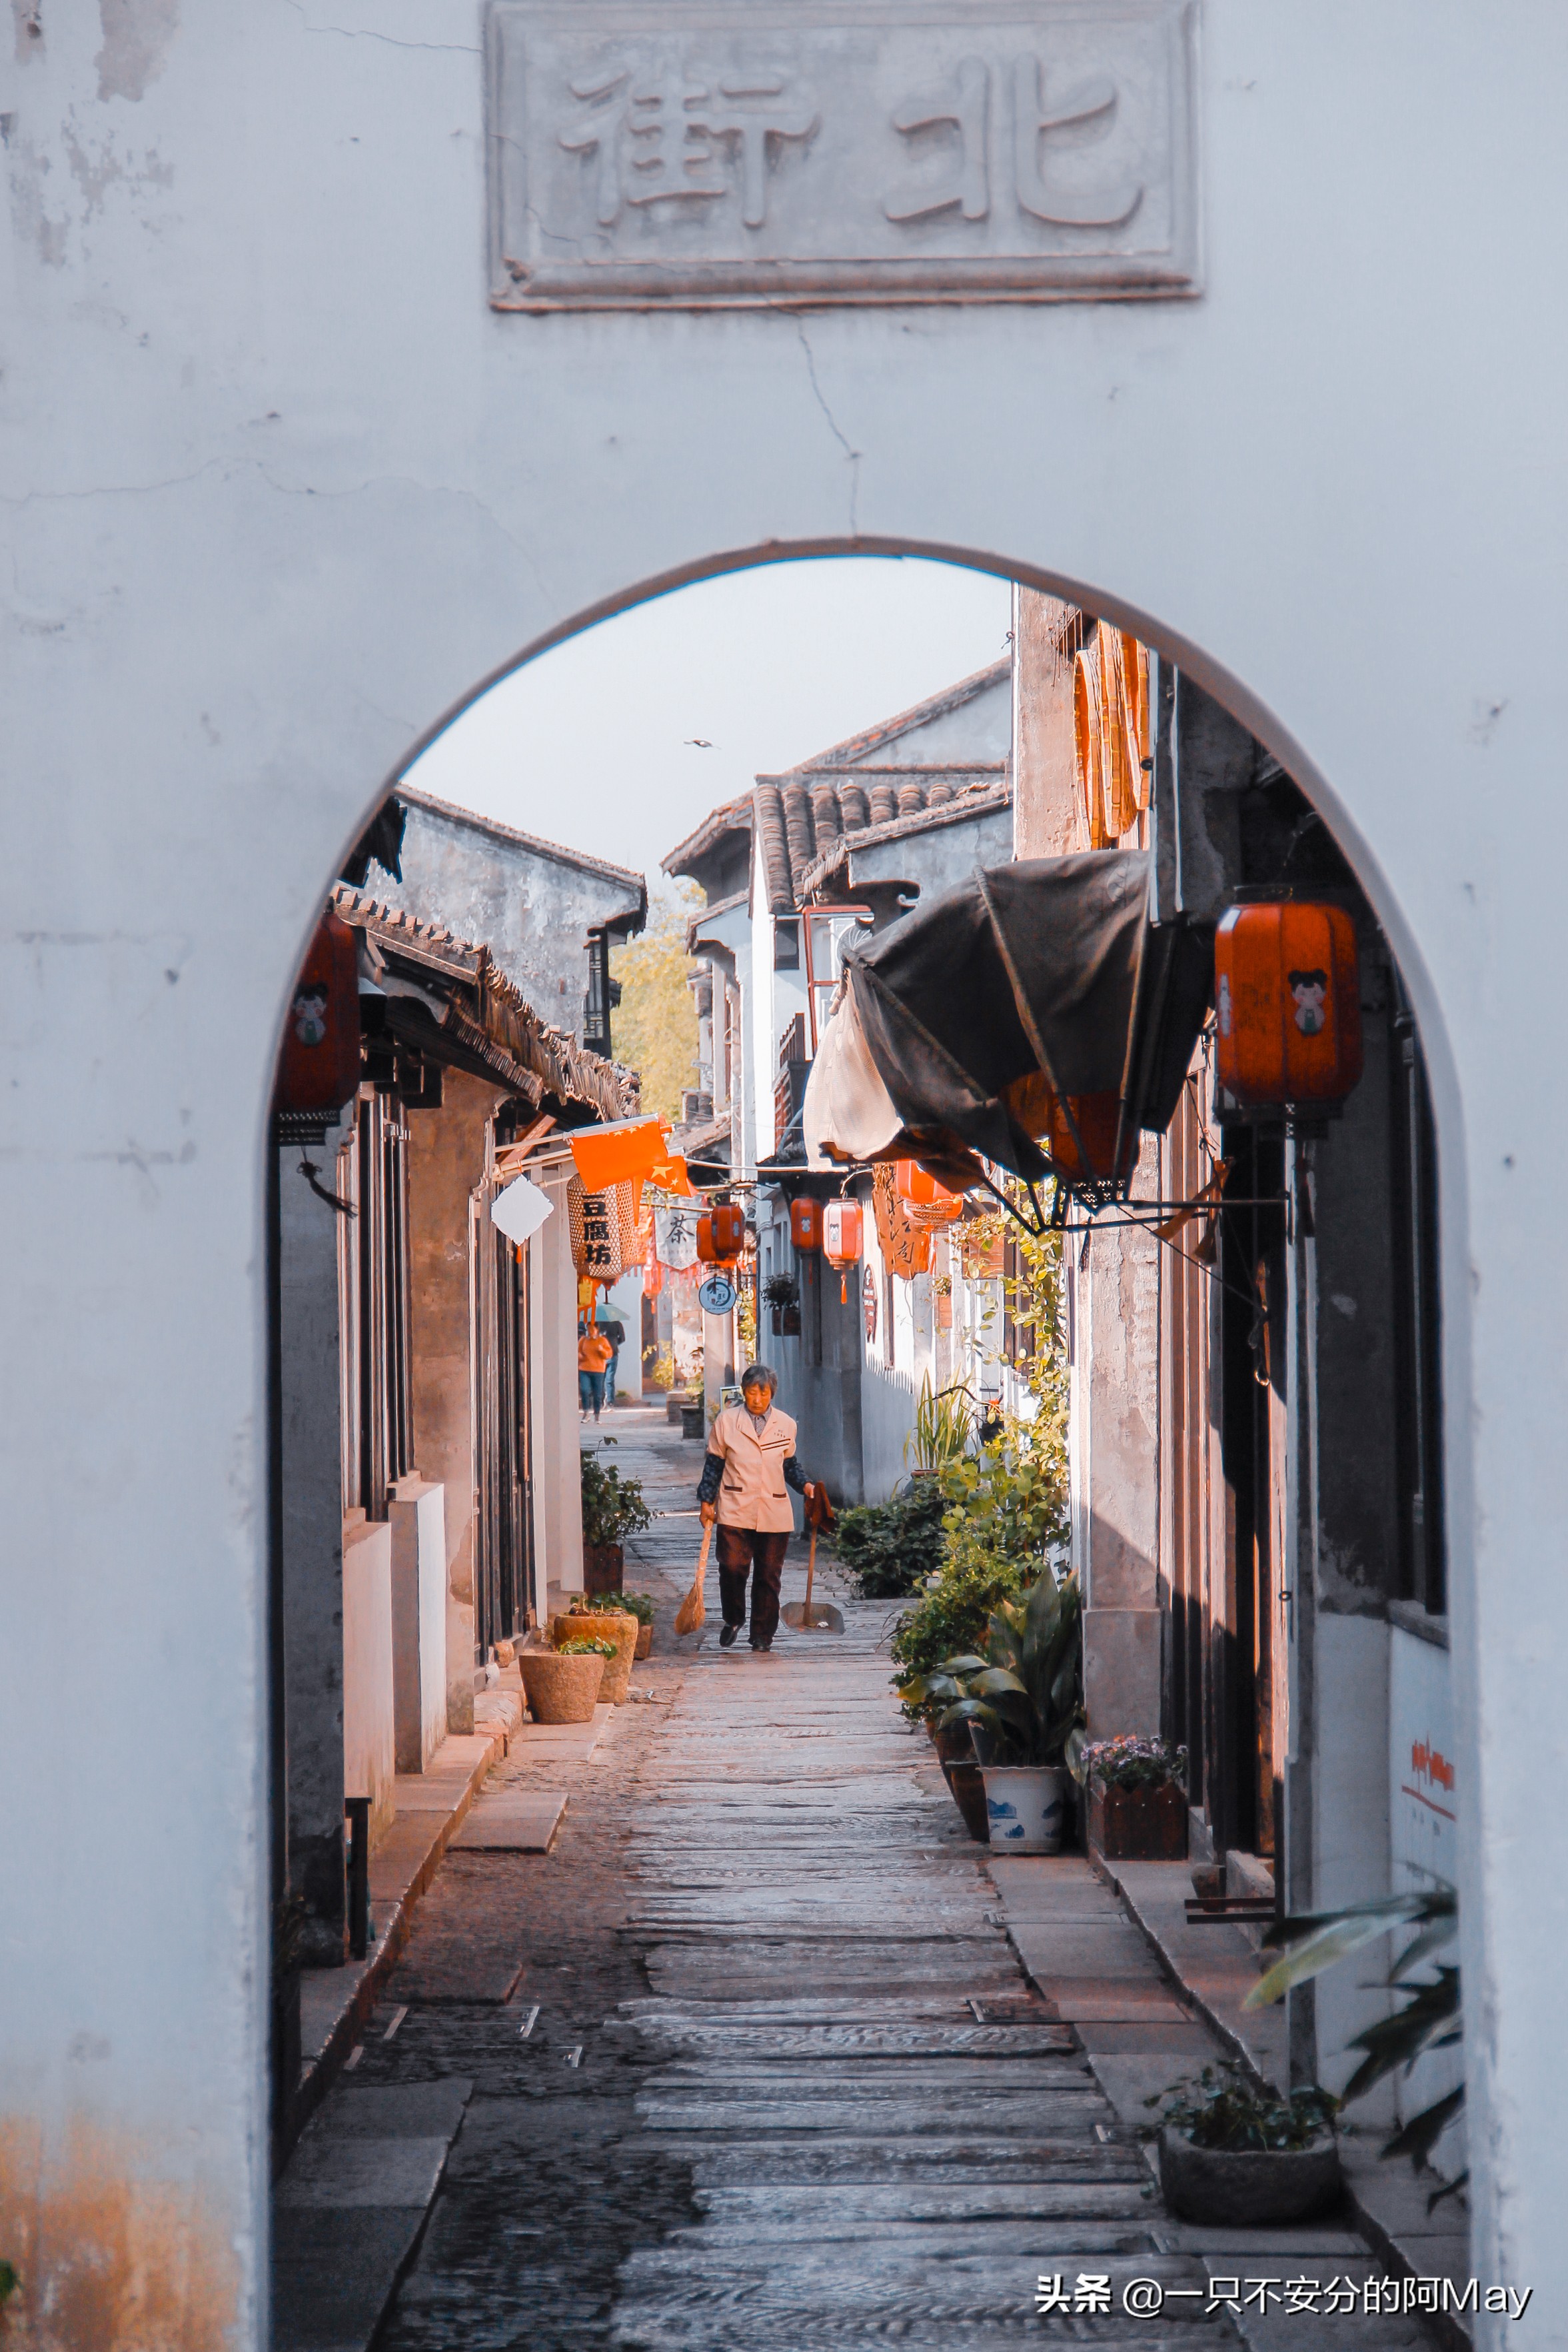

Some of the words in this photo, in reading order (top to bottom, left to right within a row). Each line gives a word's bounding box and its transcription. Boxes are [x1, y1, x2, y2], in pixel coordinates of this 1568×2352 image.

[581, 1194, 612, 1265] 豆腐坊
[666, 1214, 697, 1244] 茶
